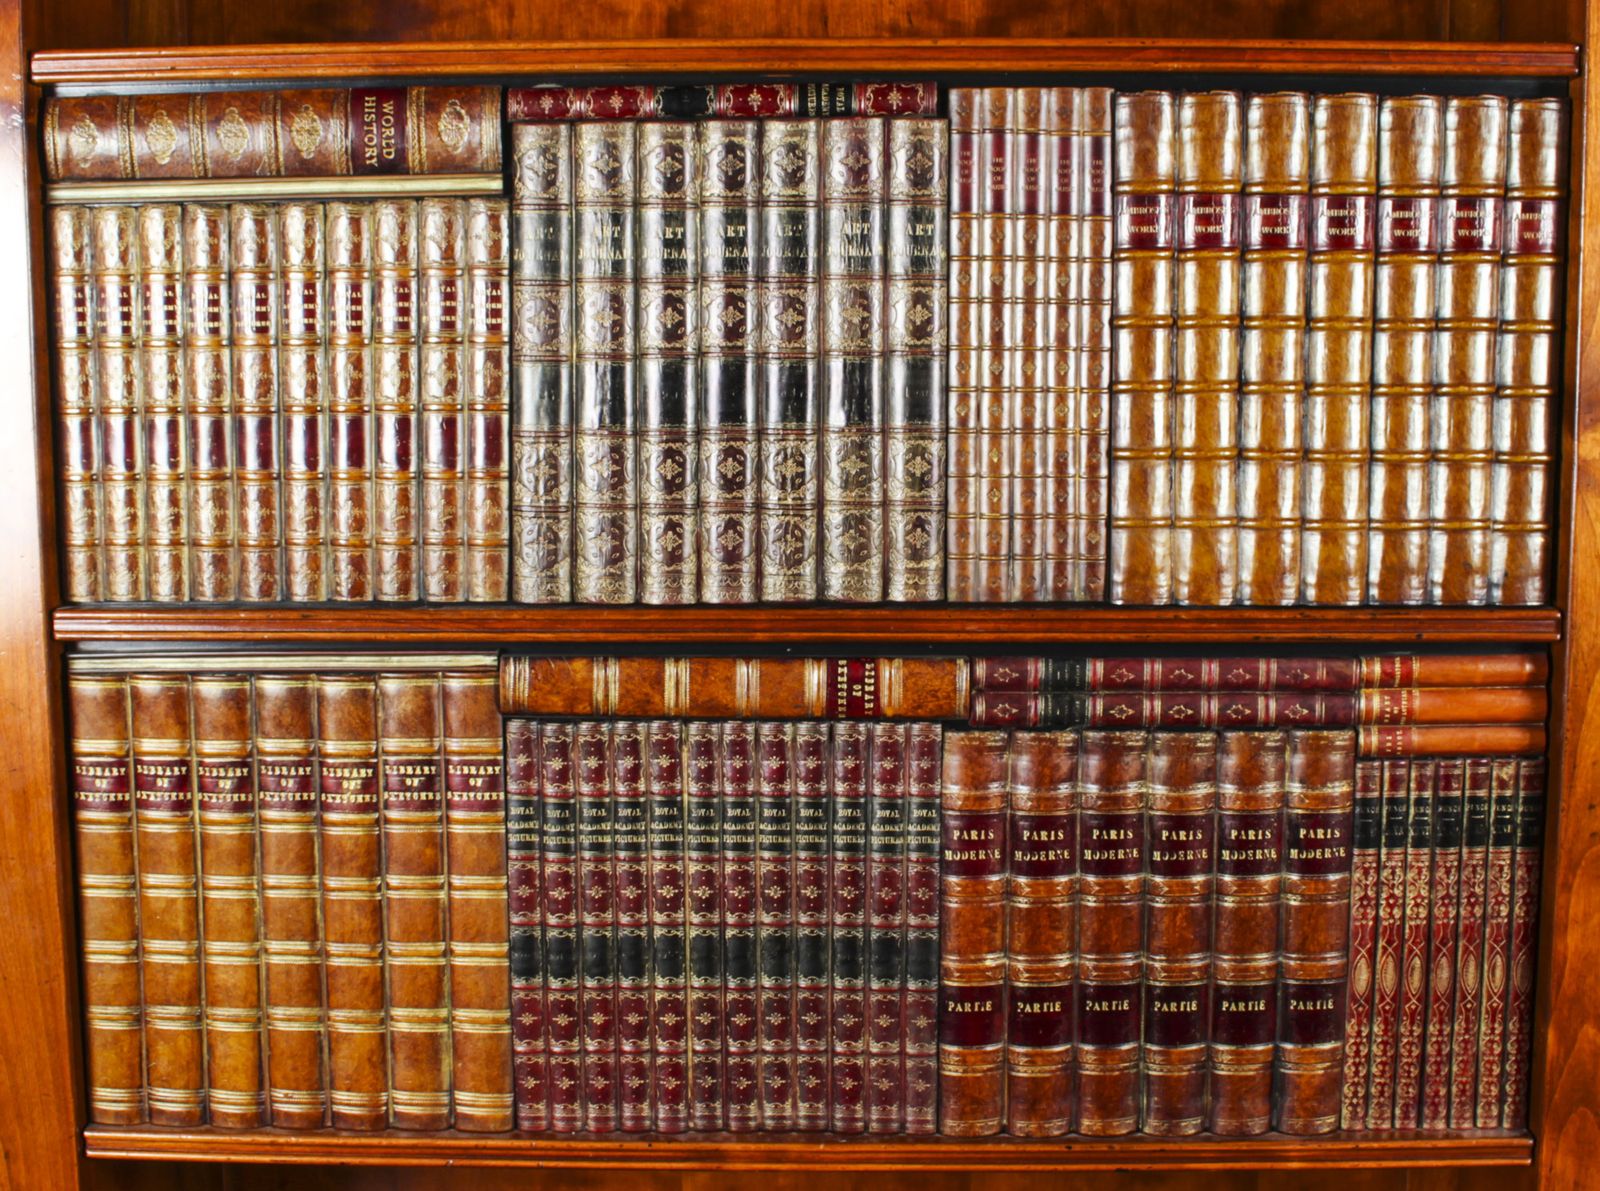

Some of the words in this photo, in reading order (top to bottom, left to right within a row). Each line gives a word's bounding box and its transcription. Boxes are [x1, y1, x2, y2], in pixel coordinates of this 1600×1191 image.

[363, 96, 379, 168] HISTORY
[381, 100, 396, 160] WORLD
[841, 223, 870, 234] ART
[906, 223, 934, 236] ART
[852, 684, 862, 697] OF
[75, 766, 126, 775] LIBRARY
[136, 764, 188, 774] LIBRARY
[198, 767, 248, 777] LIBRARY
[260, 765, 312, 775] LIBRARY
[322, 767, 373, 777] LIBRARY
[384, 765, 437, 775] LIBRARY
[448, 765, 501, 775] LIBRARY
[510, 807, 535, 815] ROYAL
[546, 809, 569, 818] ROYAL
[583, 808, 607, 817] ROYAL
[618, 808, 642, 817] ROYAL
[655, 807, 679, 815] ROYAL
[691, 808, 715, 817] ROYAL
[727, 808, 750, 817] ROYAL
[763, 809, 786, 817] ROYAL
[800, 808, 823, 817] ROYAL
[838, 808, 862, 817] ROYAL
[876, 809, 900, 818] ROYAL
[913, 809, 937, 818] ROYAL
[953, 829, 994, 841] PARIS
[1023, 830, 1064, 841] PARIS
[1092, 829, 1134, 840] PARIS
[1161, 830, 1203, 841] PARIS
[1231, 829, 1272, 841] PARIS
[1299, 828, 1341, 840] PARIS
[944, 848, 1001, 860] MODERNE
[1014, 849, 1071, 861] MODERNE
[1084, 848, 1139, 860] MODERNE
[1153, 848, 1209, 860] MODERNE
[1221, 848, 1277, 861] MODERNE
[1290, 848, 1347, 860] MODERNE
[948, 1001, 992, 1012] PARTIE
[1017, 1001, 1062, 1013] PARTIE
[1086, 999, 1130, 1012] PARTIE
[1154, 1001, 1198, 1012] PARTIE
[1222, 1000, 1265, 1012] PARTIE
[1290, 998, 1334, 1010] PARTIE
